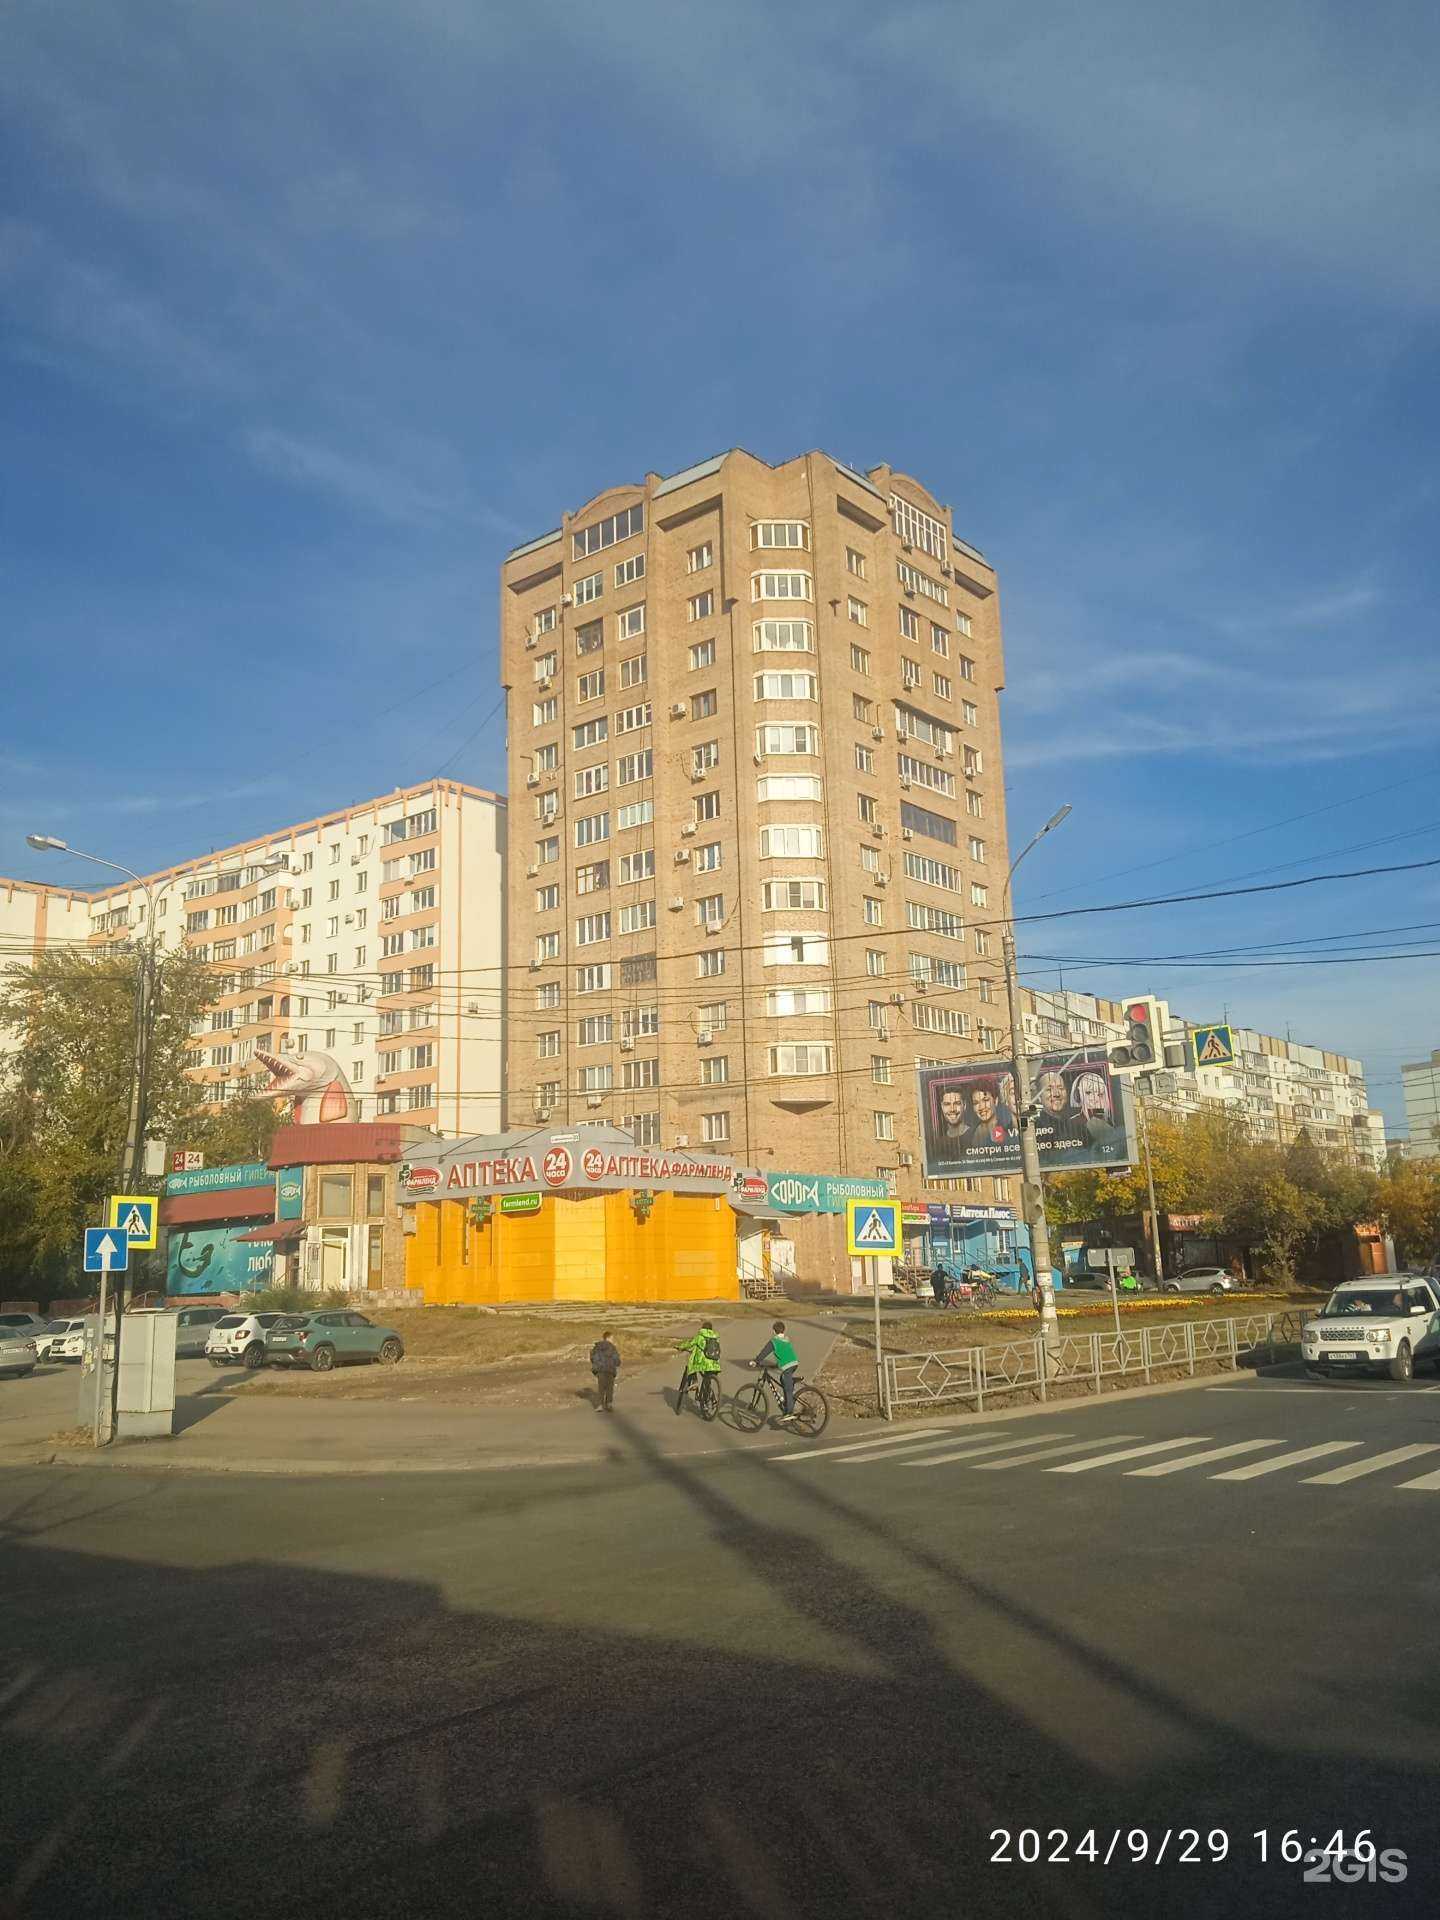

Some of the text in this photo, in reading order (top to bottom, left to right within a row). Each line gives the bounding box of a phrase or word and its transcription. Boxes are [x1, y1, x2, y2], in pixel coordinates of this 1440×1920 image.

[966, 1145, 1003, 1156] смотри
[1004, 1144, 1021, 1153] все
[1054, 1138, 1083, 1149] здесь
[546, 1152, 567, 1171] 24
[586, 1153, 602, 1166] 24
[605, 1153, 732, 1182] АПТЕКА ФАРМЛЕНД
[189, 1169, 242, 1187] РЫБОЛОВНЫЙ
[447, 1156, 539, 1190] АПТЕКА
[545, 1169, 566, 1178] часа
[771, 1178, 885, 1207] СОРОГА РЫБОЛОВНЫЙ
[503, 1197, 538, 1208] farmlend.ru
